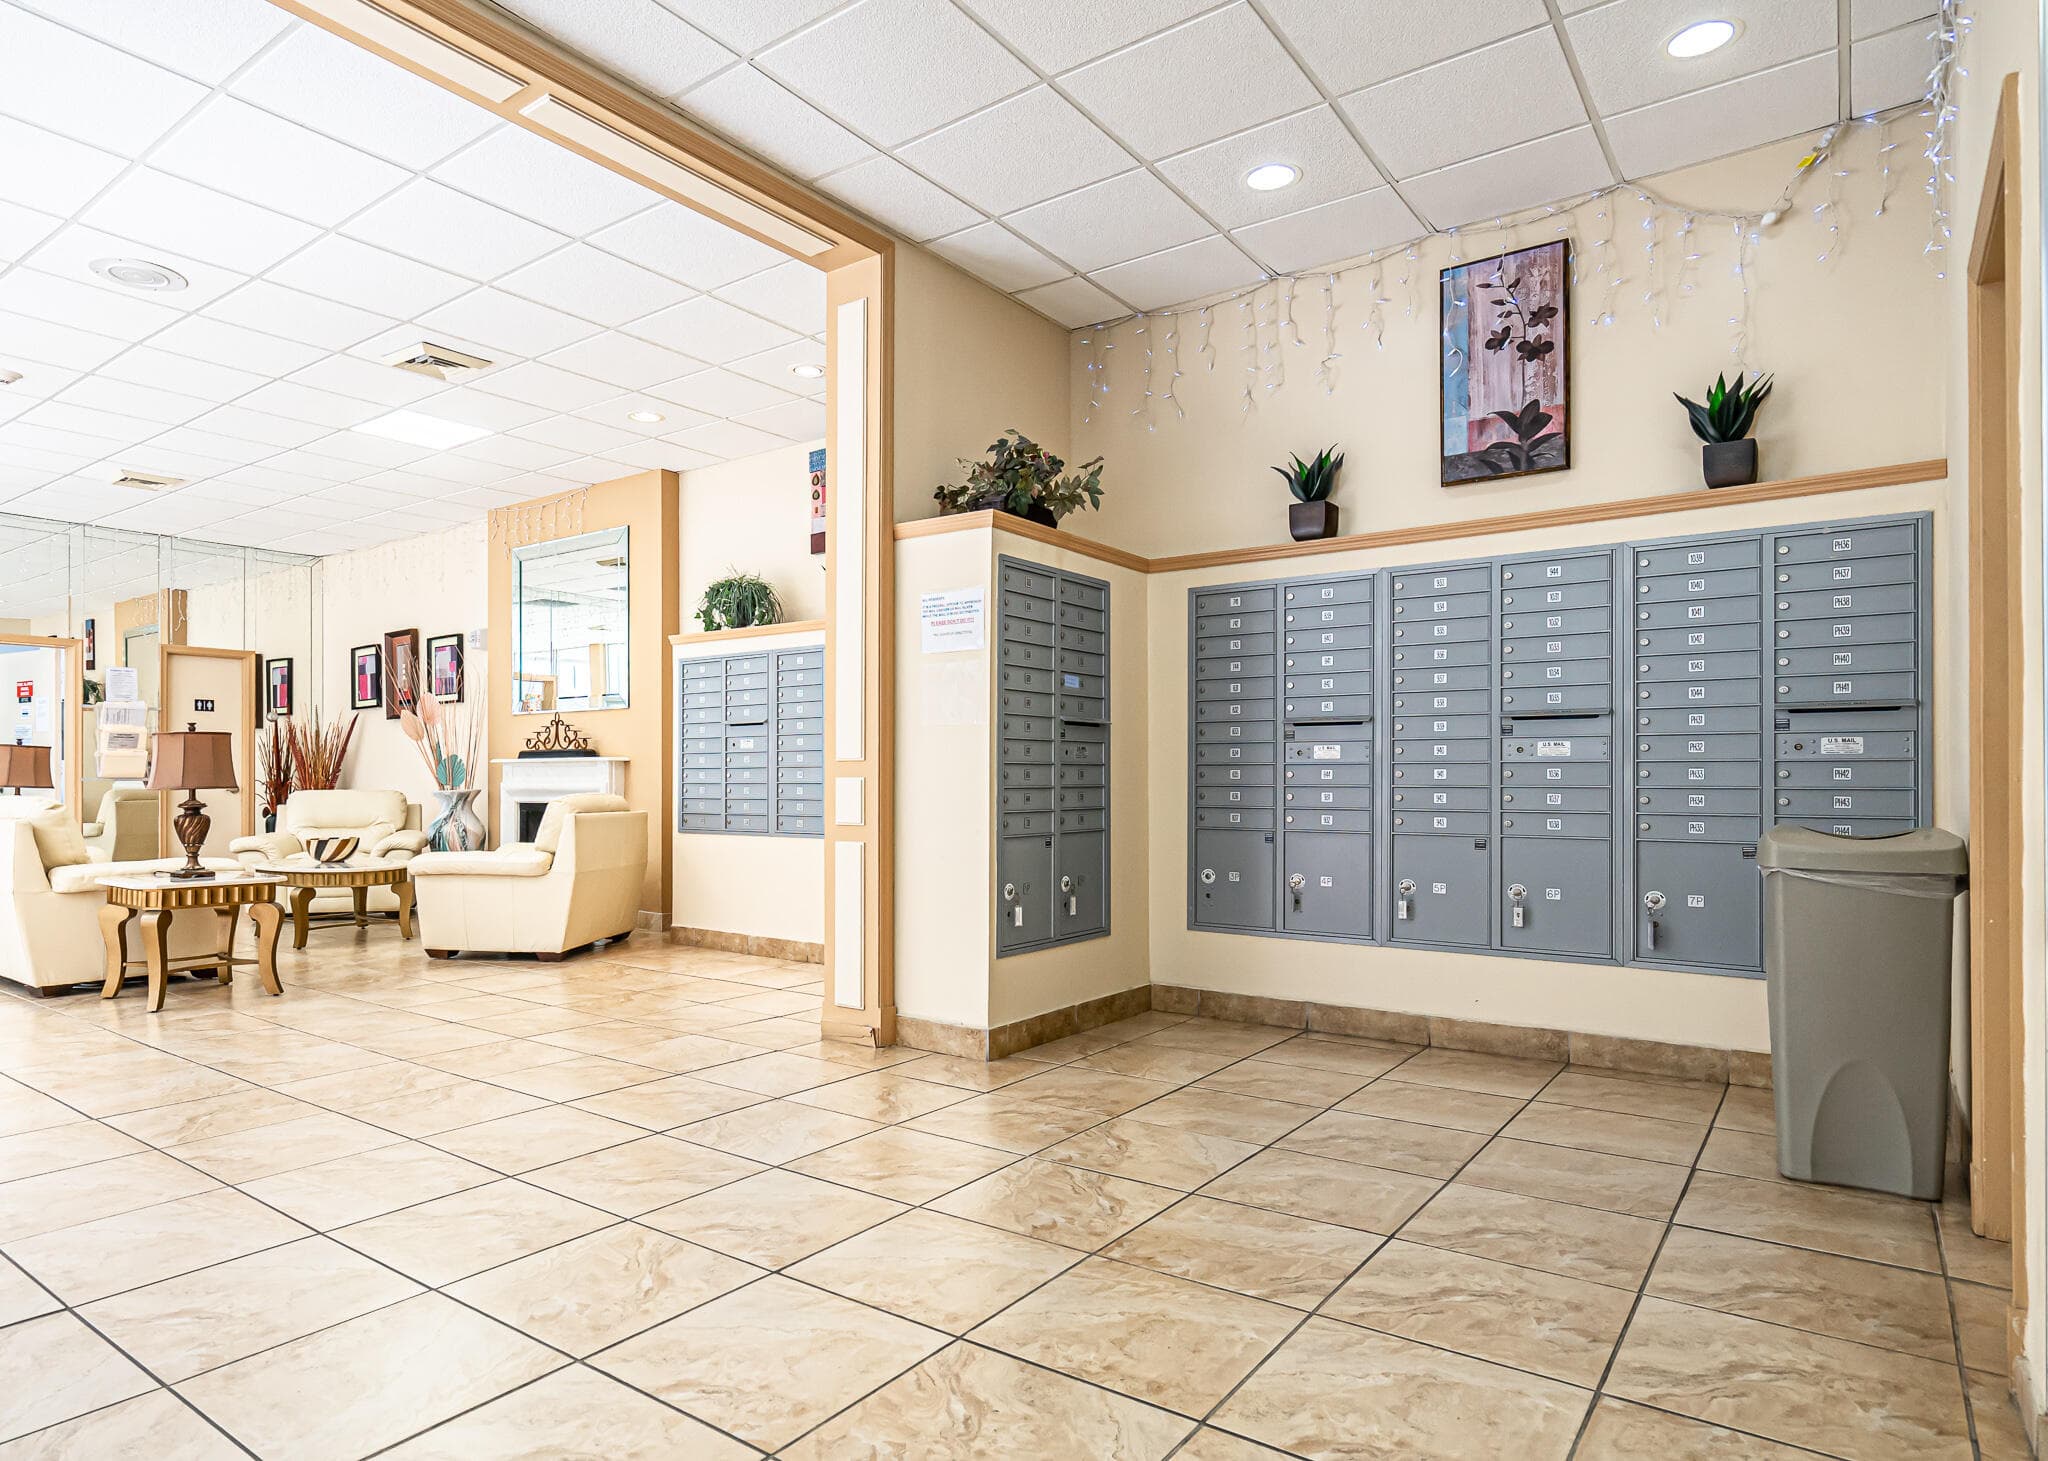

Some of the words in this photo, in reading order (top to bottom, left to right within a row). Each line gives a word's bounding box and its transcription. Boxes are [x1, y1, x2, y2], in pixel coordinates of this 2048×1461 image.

[1834, 540, 1850, 550] PH36
[1690, 554, 1702, 562] 1039
[1549, 567, 1559, 575] 944
[1834, 568, 1850, 578] PH37
[1690, 580, 1702, 590] 1040
[1834, 596, 1850, 606] PH38
[1690, 608, 1702, 616] 1041
[1834, 626, 1850, 636] PH39
[1690, 634, 1702, 644] 1042
[1834, 654, 1850, 664] PH40
[1690, 662, 1702, 670] 1043
[1834, 683, 1850, 692] PH41
[1690, 688, 1702, 698] 1044
[1690, 716, 1702, 724] PH31
[1690, 742, 1703, 752] PH32
[1548, 769, 1560, 778] 1036
[1690, 770, 1703, 778] PH33
[1834, 769, 1850, 778] PH42
[1548, 794, 1560, 802] 1037
[1690, 796, 1703, 805] PH34
[1834, 798, 1850, 807] PH43
[1690, 824, 1703, 832] PH35
[1834, 826, 1850, 835] PH44
[1547, 890, 1559, 898] 6P
[1690, 897, 1703, 905] 7P
